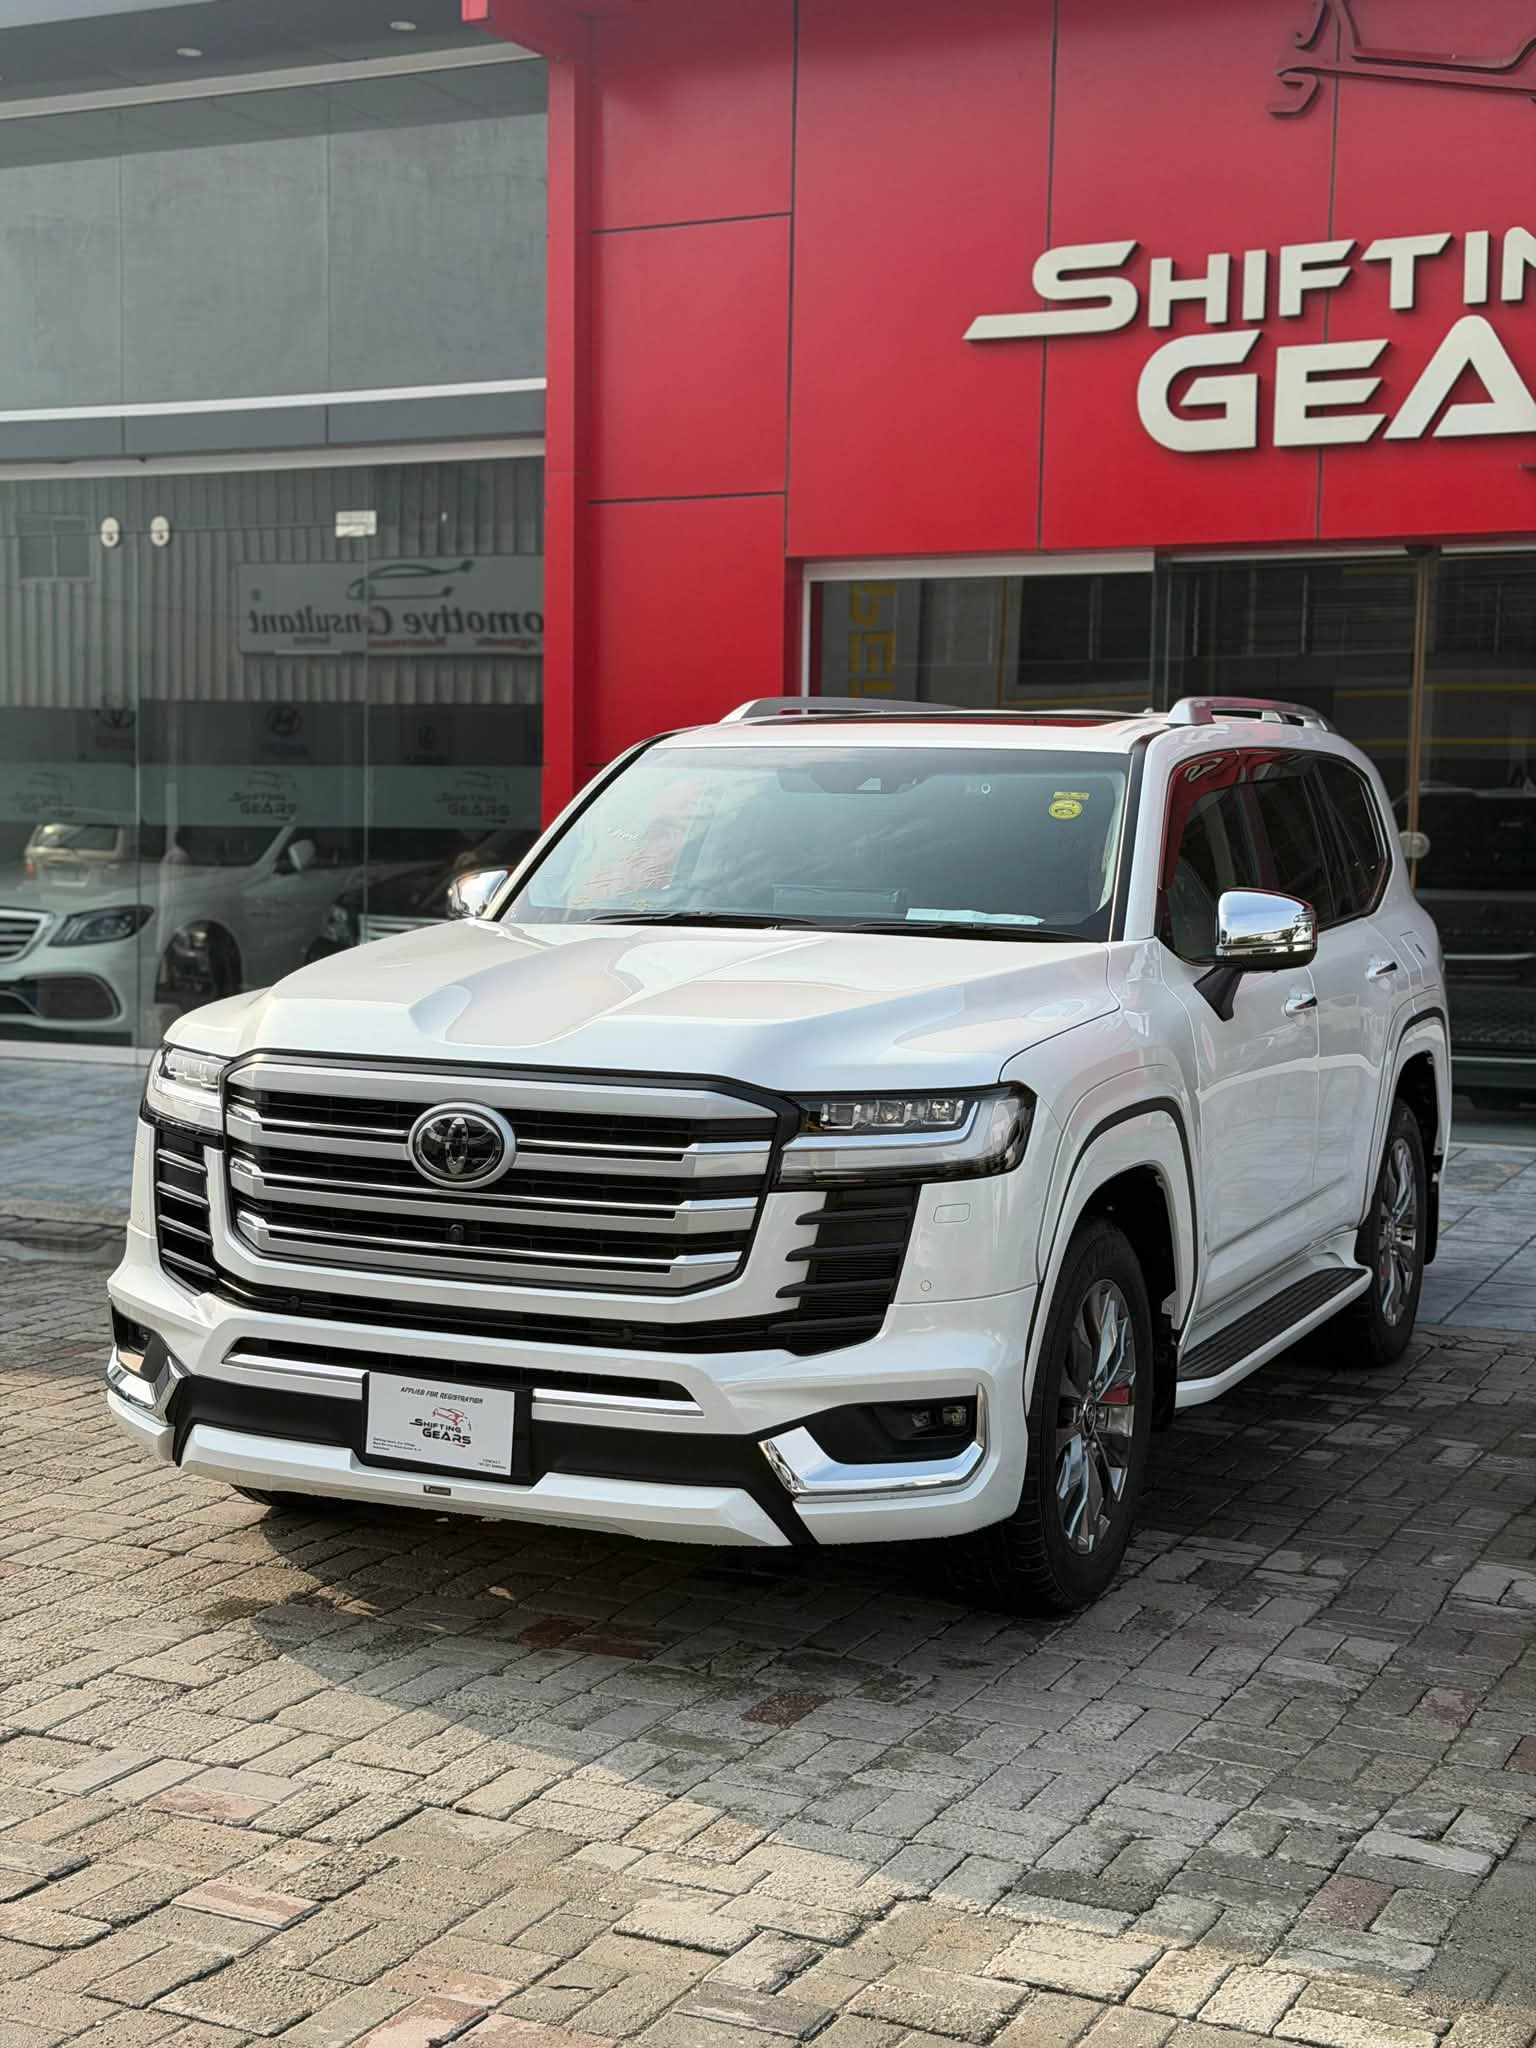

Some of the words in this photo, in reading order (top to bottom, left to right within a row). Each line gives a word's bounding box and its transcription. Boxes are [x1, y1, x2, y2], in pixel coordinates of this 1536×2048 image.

[400, 1386, 426, 1396] APPLIED
[425, 1390, 439, 1399] FOR
[440, 1392, 484, 1405] REGISTRATION
[409, 1418, 462, 1433] SHIFTING
[422, 1428, 471, 1445] GEARS
